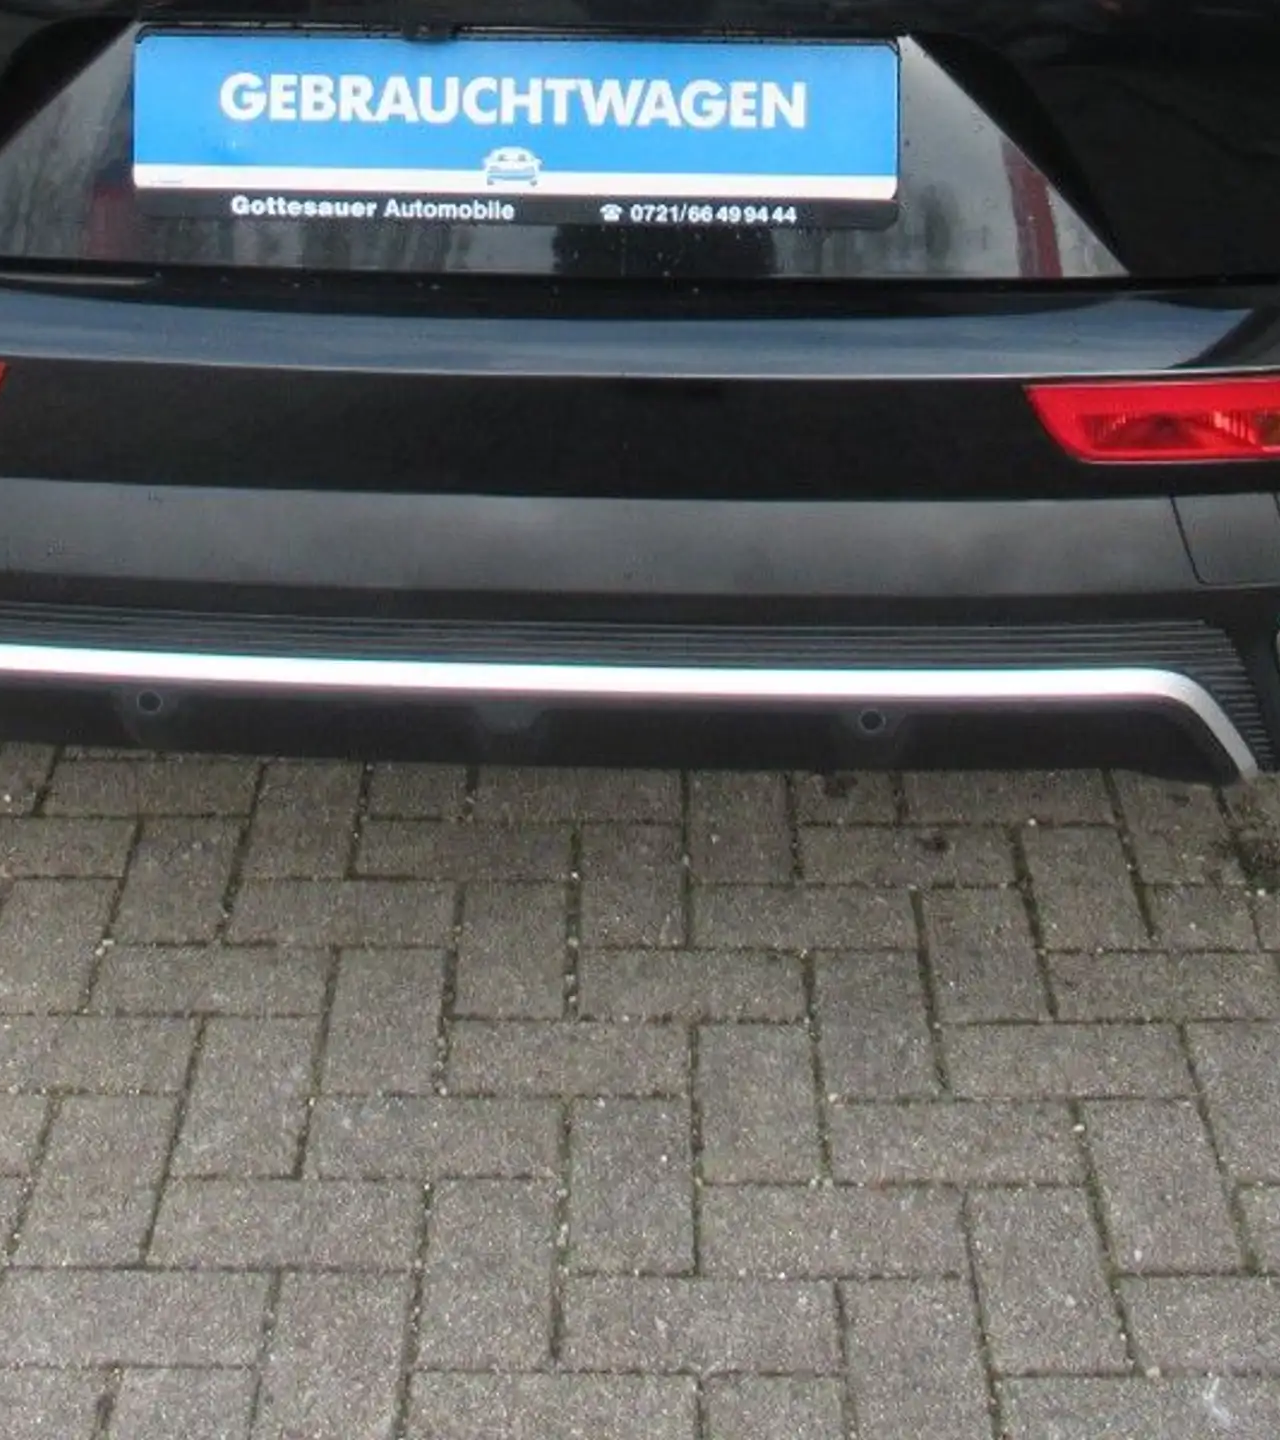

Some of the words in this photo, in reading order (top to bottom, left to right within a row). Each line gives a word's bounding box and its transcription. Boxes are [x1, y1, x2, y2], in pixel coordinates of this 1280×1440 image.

[219, 72, 807, 130] GEBRAUCHTWAGEN
[230, 195, 377, 217] Gottesauer
[383, 199, 516, 220] Automobile
